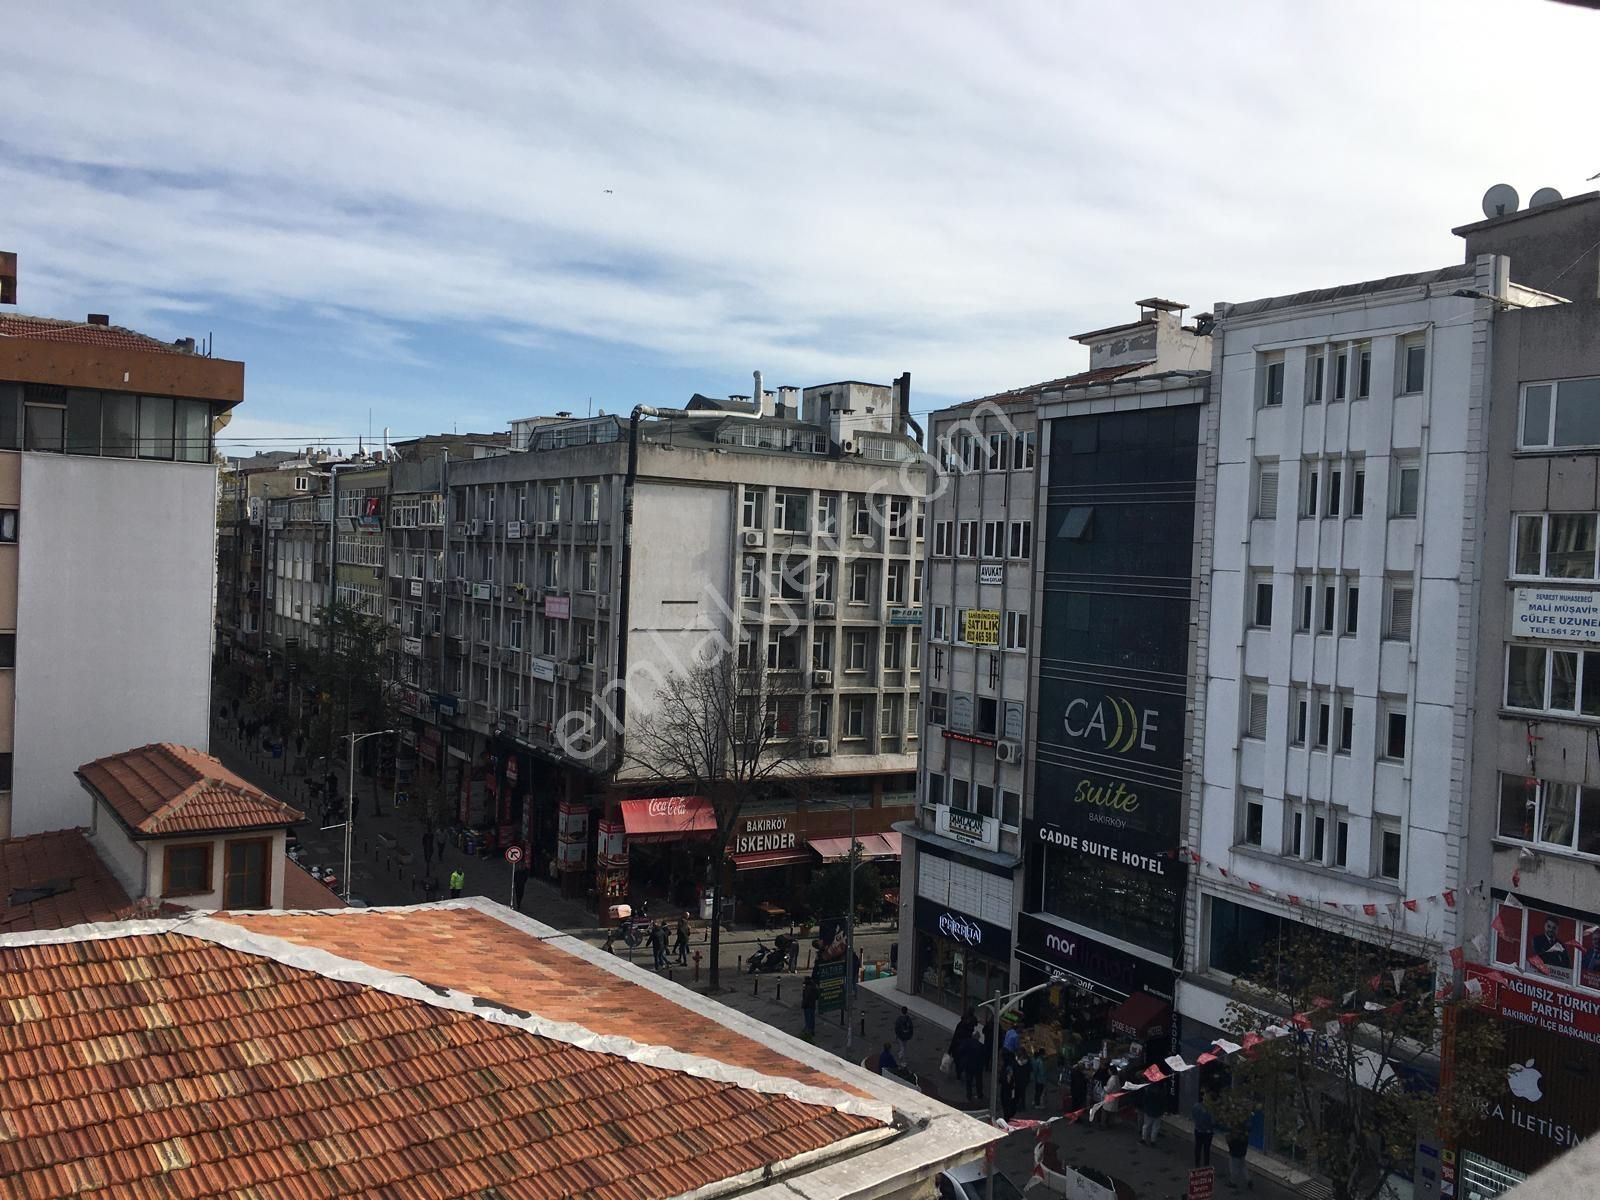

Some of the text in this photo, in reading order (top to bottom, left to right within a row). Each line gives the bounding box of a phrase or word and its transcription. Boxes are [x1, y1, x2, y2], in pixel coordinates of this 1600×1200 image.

[981, 567, 1002, 577] AVUKAT
[1529, 603, 1598, 615] MALİ MÜŞAVİR
[967, 619, 998, 631] SATILIK
[1520, 613, 1600, 627] GÜLFE UZUNE
[746, 816, 788, 832] BAKIRKÖY
[736, 833, 796, 853] İSKENDER
[1040, 827, 1165, 876] CADDE SUITE HOTEL
[1046, 933, 1076, 956] mor
[1502, 1007, 1538, 1025] BAKIRKÖY
[1540, 1018, 1557, 1031] İLÇE
[1531, 1001, 1574, 1023] PARTİSİ
